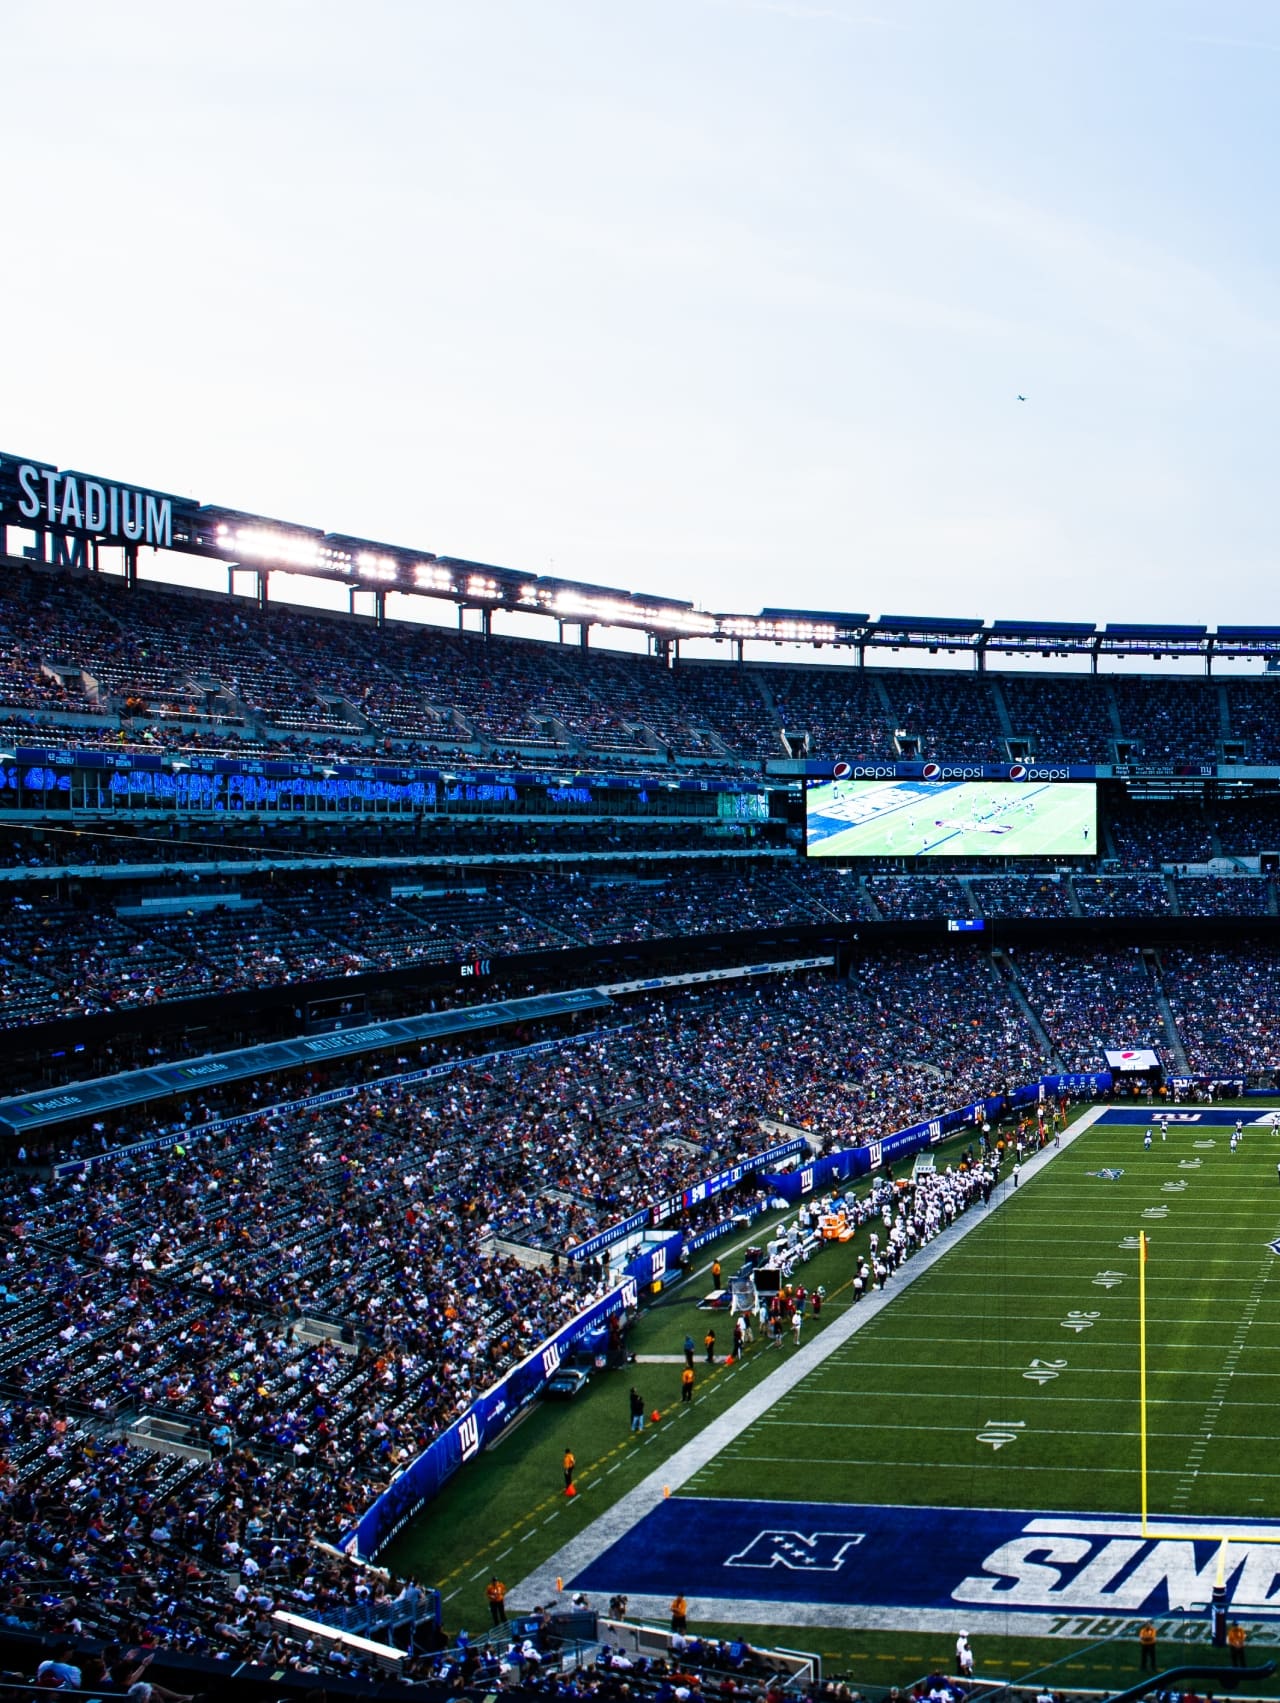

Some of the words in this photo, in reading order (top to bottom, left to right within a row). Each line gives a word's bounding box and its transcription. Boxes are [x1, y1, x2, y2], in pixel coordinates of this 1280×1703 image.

[18, 464, 172, 547] STADIUM
[853, 764, 897, 780] pepsi
[941, 765, 984, 781] pepsi
[1027, 766, 1070, 782] pepsi
[461, 964, 474, 977] EN
[345, 1028, 391, 1044] STADIUM
[186, 1062, 229, 1076] MetLife
[32, 1095, 82, 1112] MetLife
[869, 1142, 882, 1170] ny
[929, 1120, 940, 1143] ny
[801, 1167, 813, 1193] ny
[574, 1249, 584, 1260] NEW
[602, 1228, 625, 1245] FOOTBALL
[627, 1215, 645, 1231] GIANTS
[651, 1246, 666, 1280] ny
[1092, 1270, 1128, 1285] 40
[1060, 1310, 1101, 1328] 30
[541, 1341, 560, 1378] ny
[1022, 1358, 1068, 1380] 20
[458, 1413, 479, 1462] ny
[976, 1420, 1026, 1443] 10
